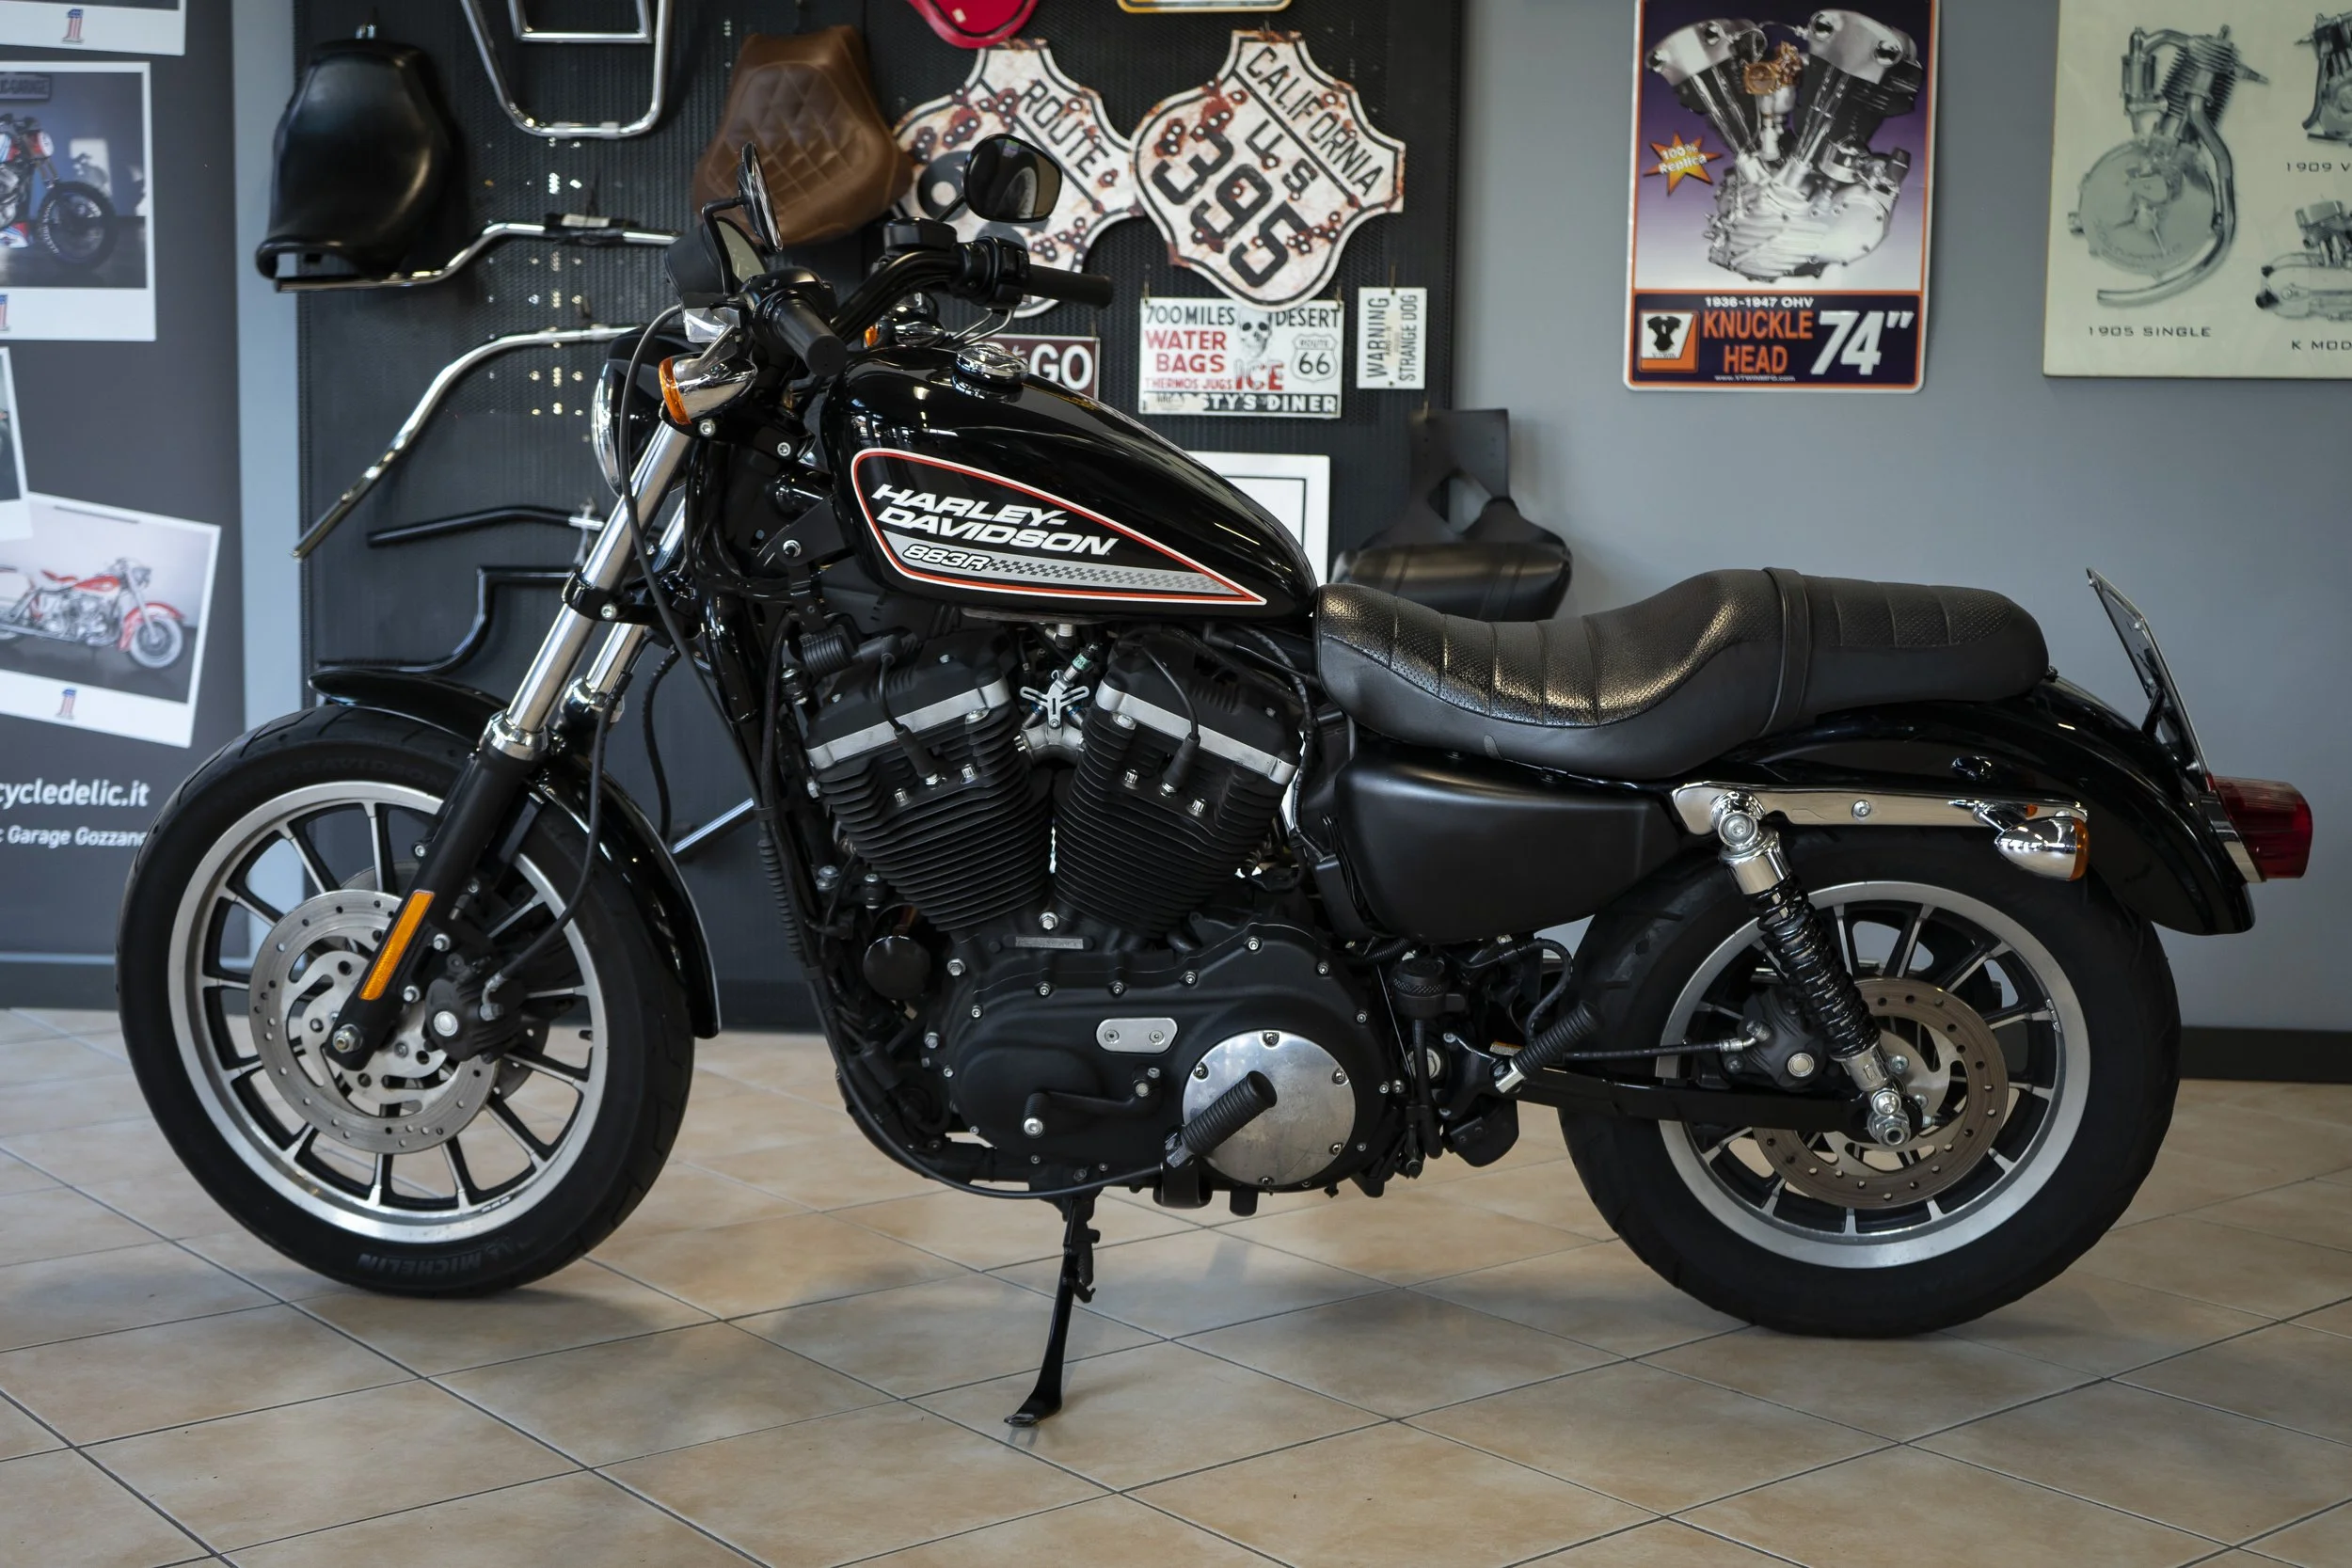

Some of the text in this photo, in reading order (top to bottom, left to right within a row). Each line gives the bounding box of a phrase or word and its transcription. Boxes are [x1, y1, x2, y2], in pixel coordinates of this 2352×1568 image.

[1019, 79, 1110, 178] ROUTE
[1246, 46, 1384, 196] CALIFORNIA
[1661, 143, 1699, 161] 100%
[1658, 154, 1708, 174] Replica
[2286, 162, 2332, 172] 1909
[1151, 129, 1309, 288] 395
[1705, 296, 1814, 308] 1936-1947 OHV
[1276, 308, 1340, 327] DESERT
[1703, 309, 1814, 340] KNUCKLE
[1145, 330, 1227, 351] WATER
[1367, 297, 1390, 378] WARNING
[1399, 294, 1418, 381] STRANGE DOG
[2090, 326, 2211, 337] 1905 SINGLE
[2292, 341, 2301, 350] K
[1030, 343, 1093, 390] GO
[1156, 354, 1226, 372] BAGS
[1298, 352, 1330, 374] 66
[1724, 344, 1788, 373] HEAD
[1145, 378, 1232, 390] THERMOS JUGS
[1234, 358, 1285, 390] ICE
[1266, 396, 1337, 412] DINER
[871, 483, 1068, 527] HARLEY-
[877, 506, 1120, 556] DAVIDSON
[902, 543, 992, 572] 883R
[8, 825, 72, 848] Garage
[356, 1252, 483, 1276] MICHELIN
